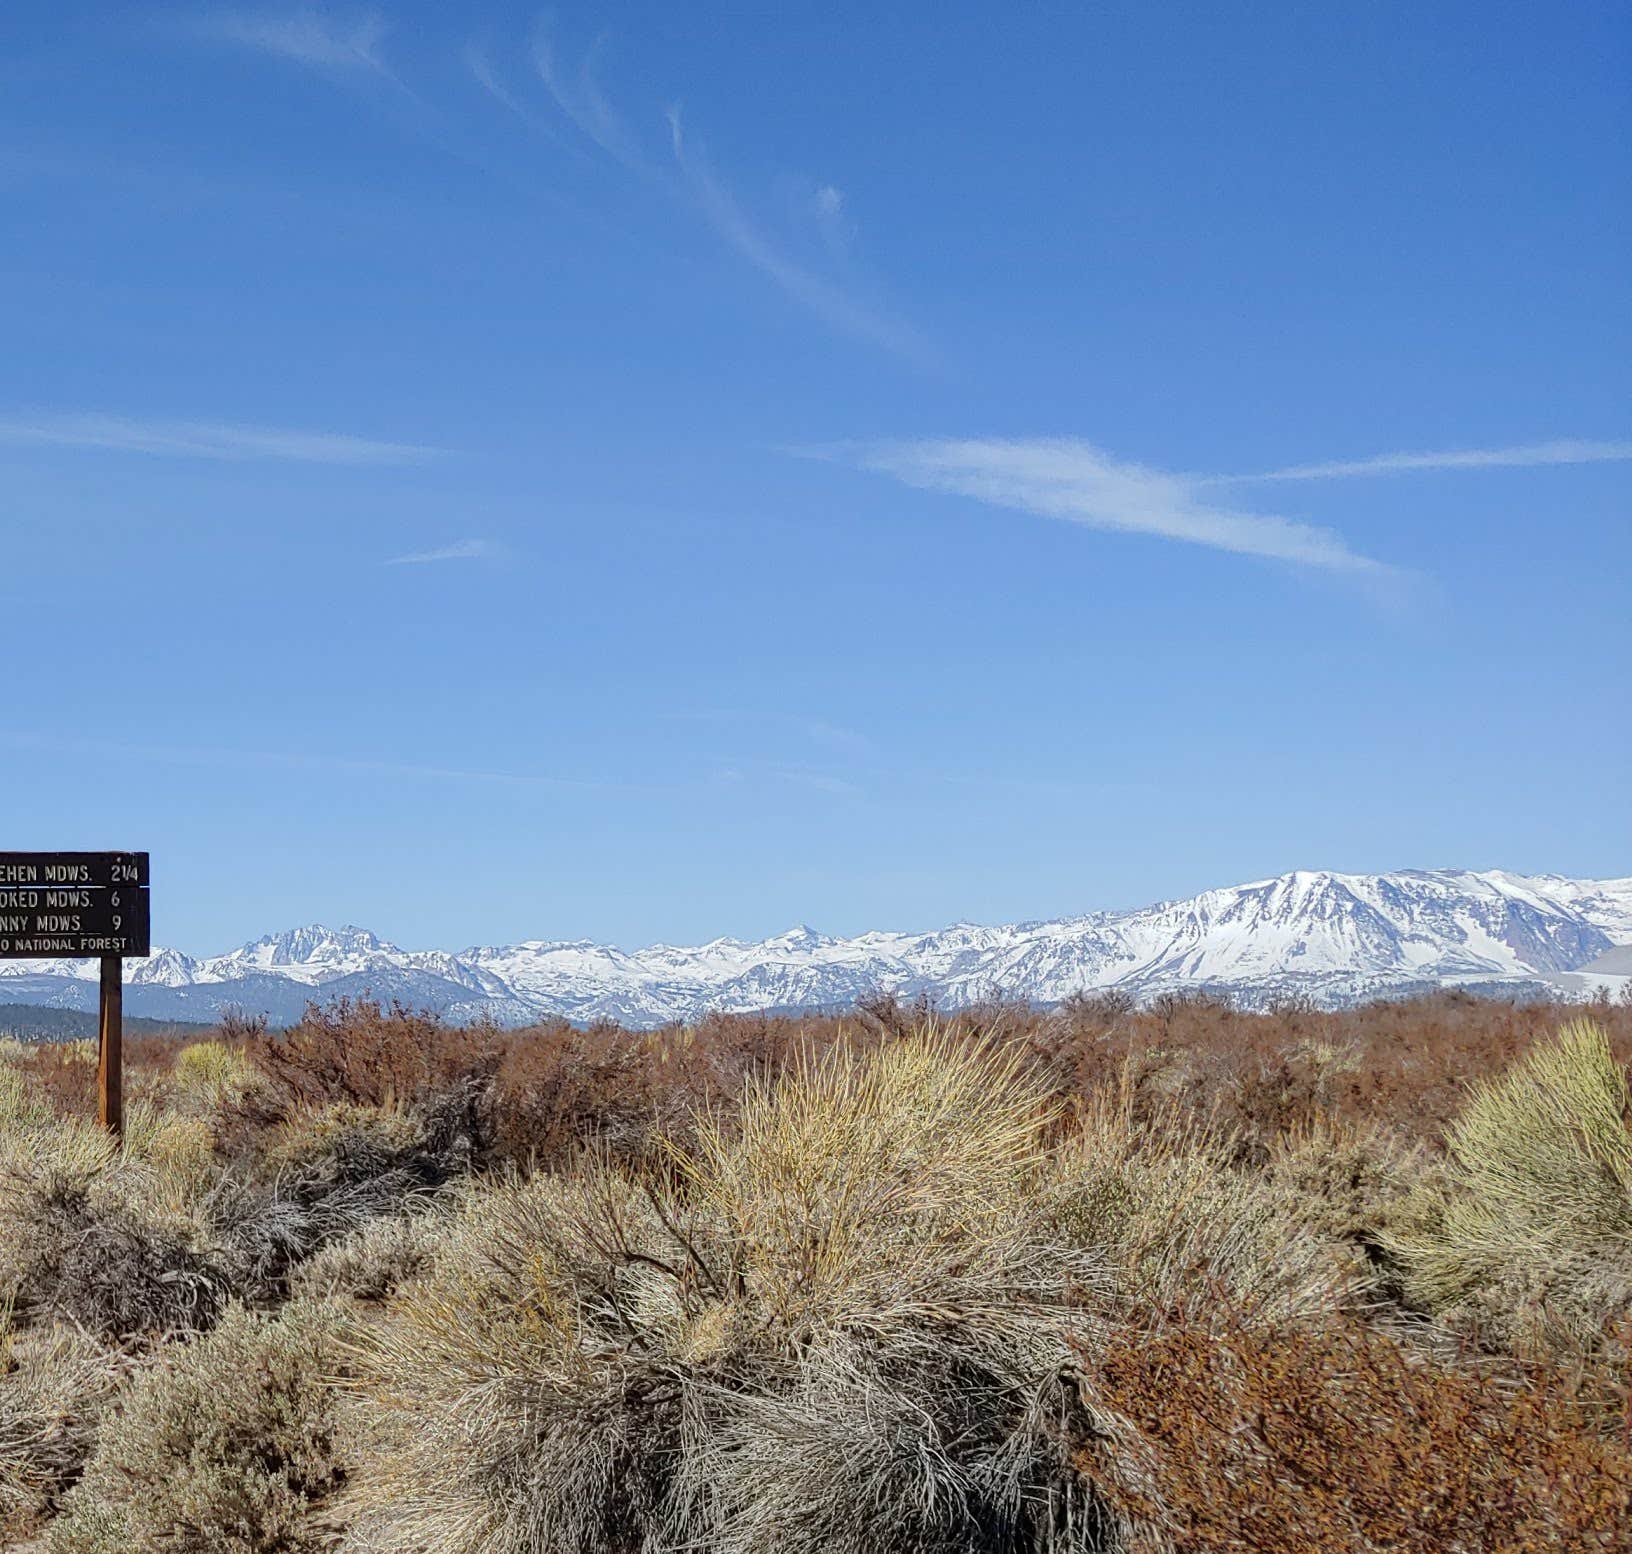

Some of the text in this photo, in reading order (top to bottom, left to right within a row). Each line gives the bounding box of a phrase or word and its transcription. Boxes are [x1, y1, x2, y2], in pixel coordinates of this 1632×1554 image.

[45, 865, 93, 882] MDWS.
[46, 891, 94, 908] MDWS.
[111, 891, 120, 906] 6
[112, 915, 121, 931] 9
[15, 938, 76, 951] NATIONAL
[80, 937, 127, 950] FOREST
